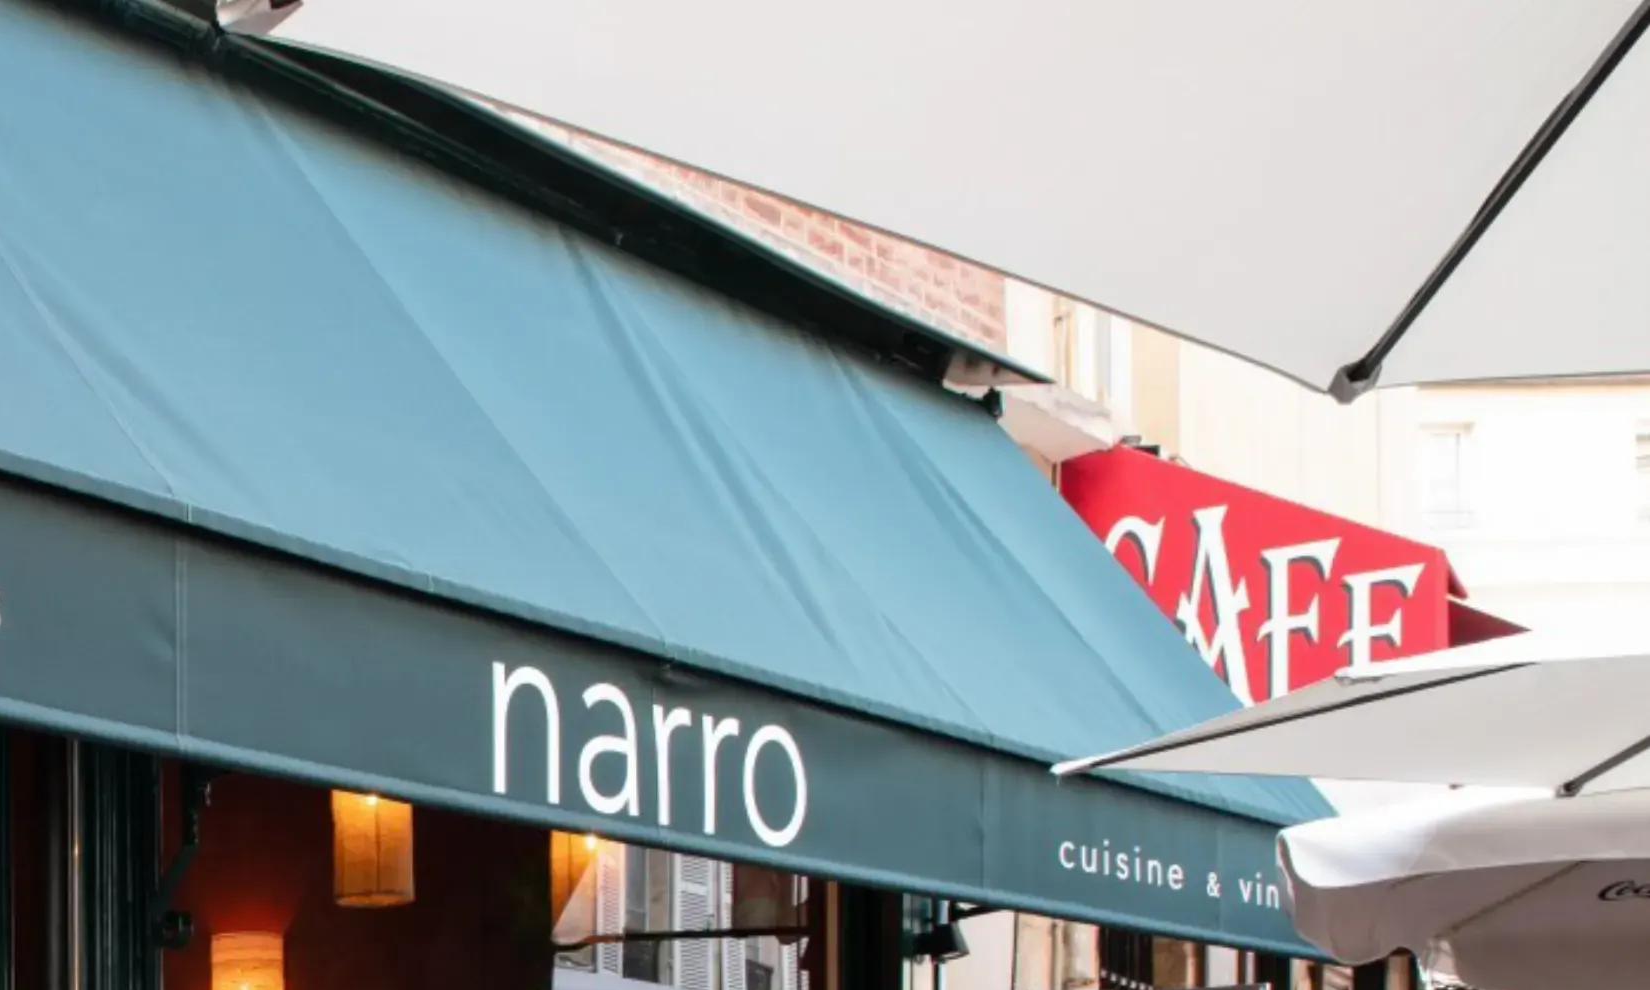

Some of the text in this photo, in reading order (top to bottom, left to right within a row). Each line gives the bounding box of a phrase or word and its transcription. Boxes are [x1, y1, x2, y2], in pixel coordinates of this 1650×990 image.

[492, 661, 807, 847] narro
[1058, 839, 1280, 909] cuisine & vin
